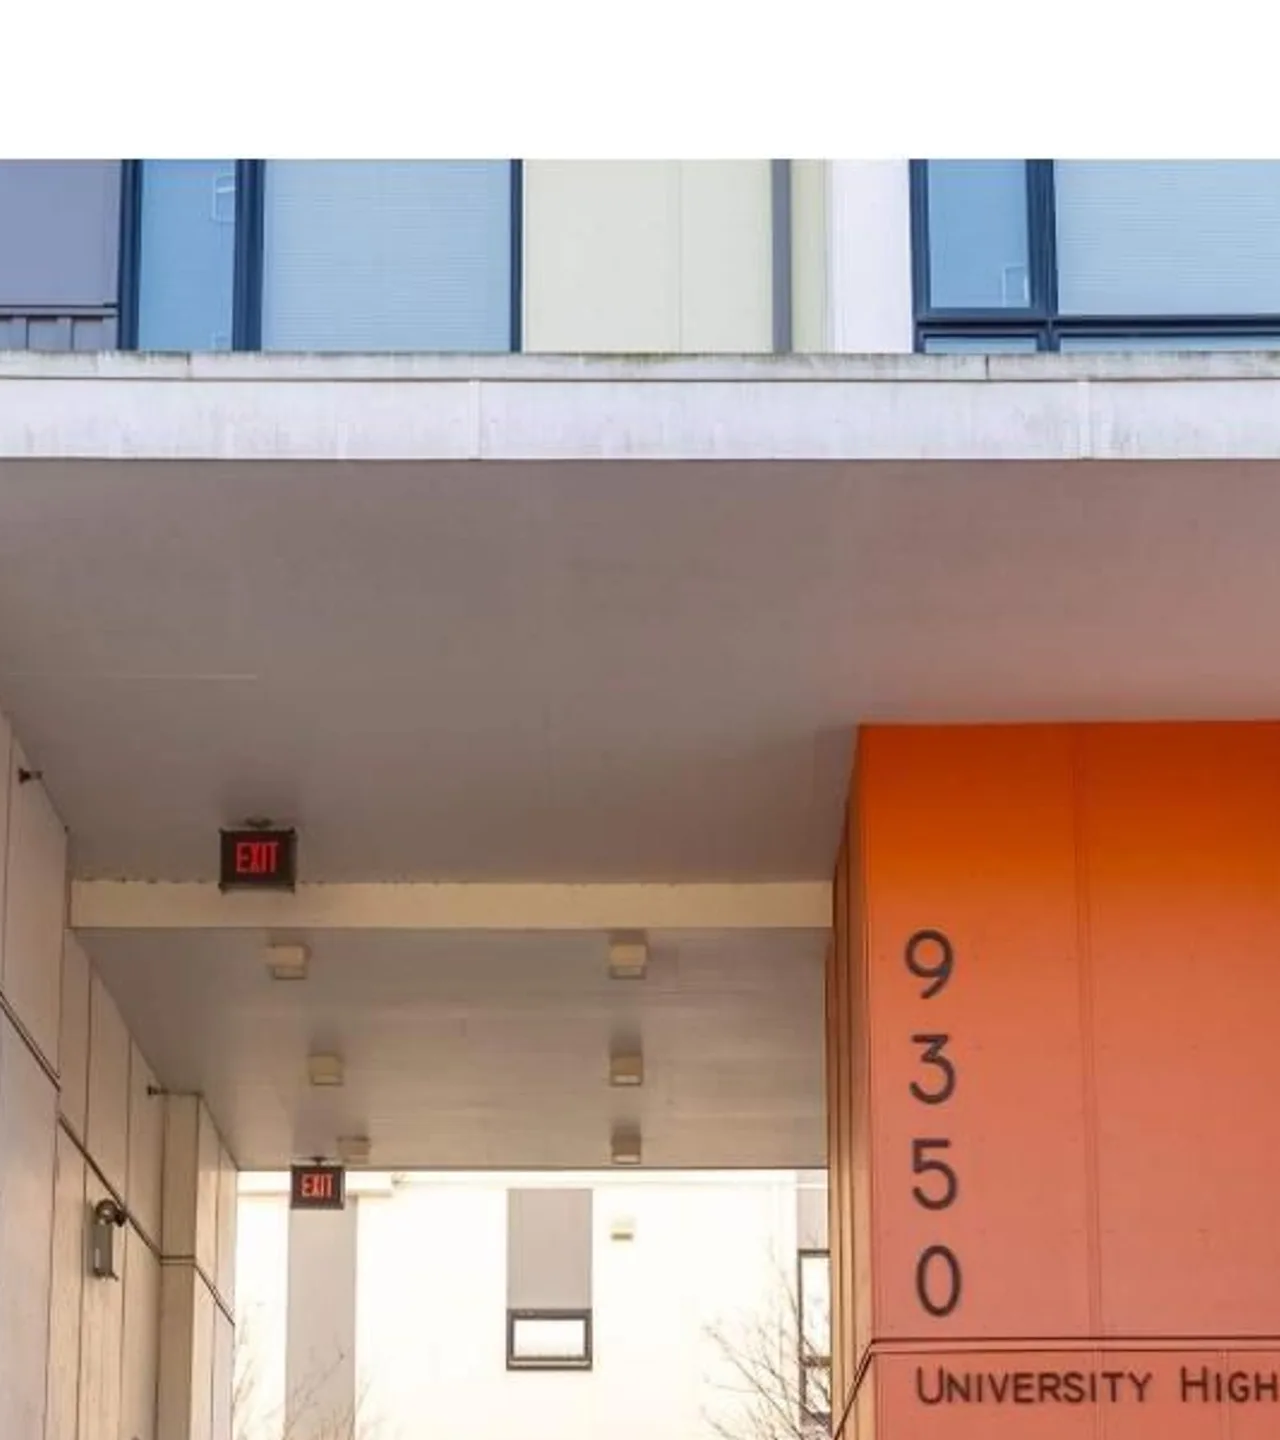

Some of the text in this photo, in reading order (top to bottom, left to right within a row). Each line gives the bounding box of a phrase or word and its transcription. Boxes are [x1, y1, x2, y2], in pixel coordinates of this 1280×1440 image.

[236, 842, 279, 873] EXIT
[904, 929, 962, 1318] 9350
[302, 1174, 334, 1198] EXIT
[916, 1366, 1154, 1404] UNIVERSITY
[1180, 1366, 1280, 1403] HIGH
